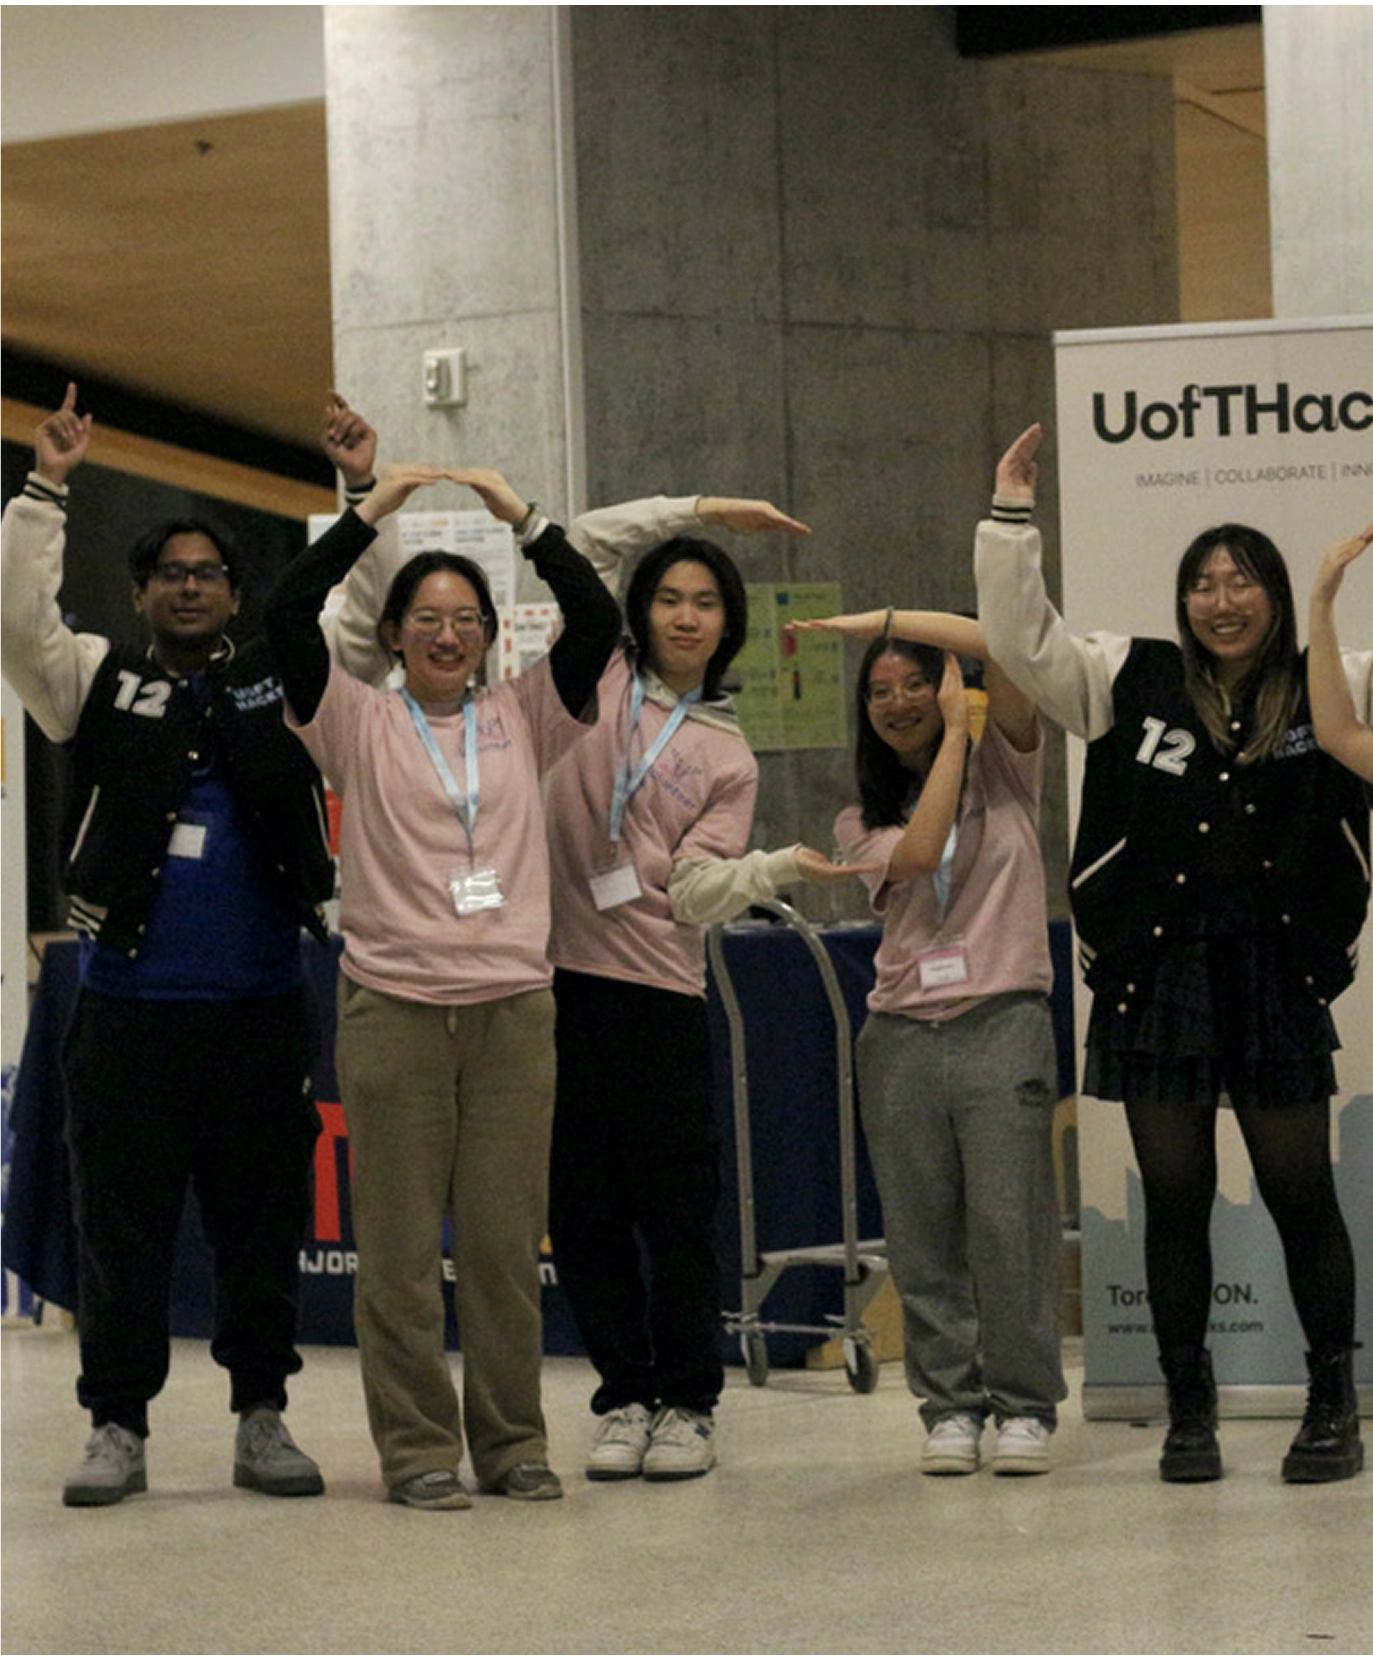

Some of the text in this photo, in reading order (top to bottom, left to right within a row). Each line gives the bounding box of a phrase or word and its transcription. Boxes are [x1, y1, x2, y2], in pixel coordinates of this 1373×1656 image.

[1093, 382, 1373, 444] UofTHac
[1135, 469, 1200, 487] IMAGINE
[1214, 463, 1328, 485] COLLABORATE
[113, 669, 173, 719] 12
[1135, 715, 1197, 777] 12
[1213, 1282, 1259, 1305] ON.
